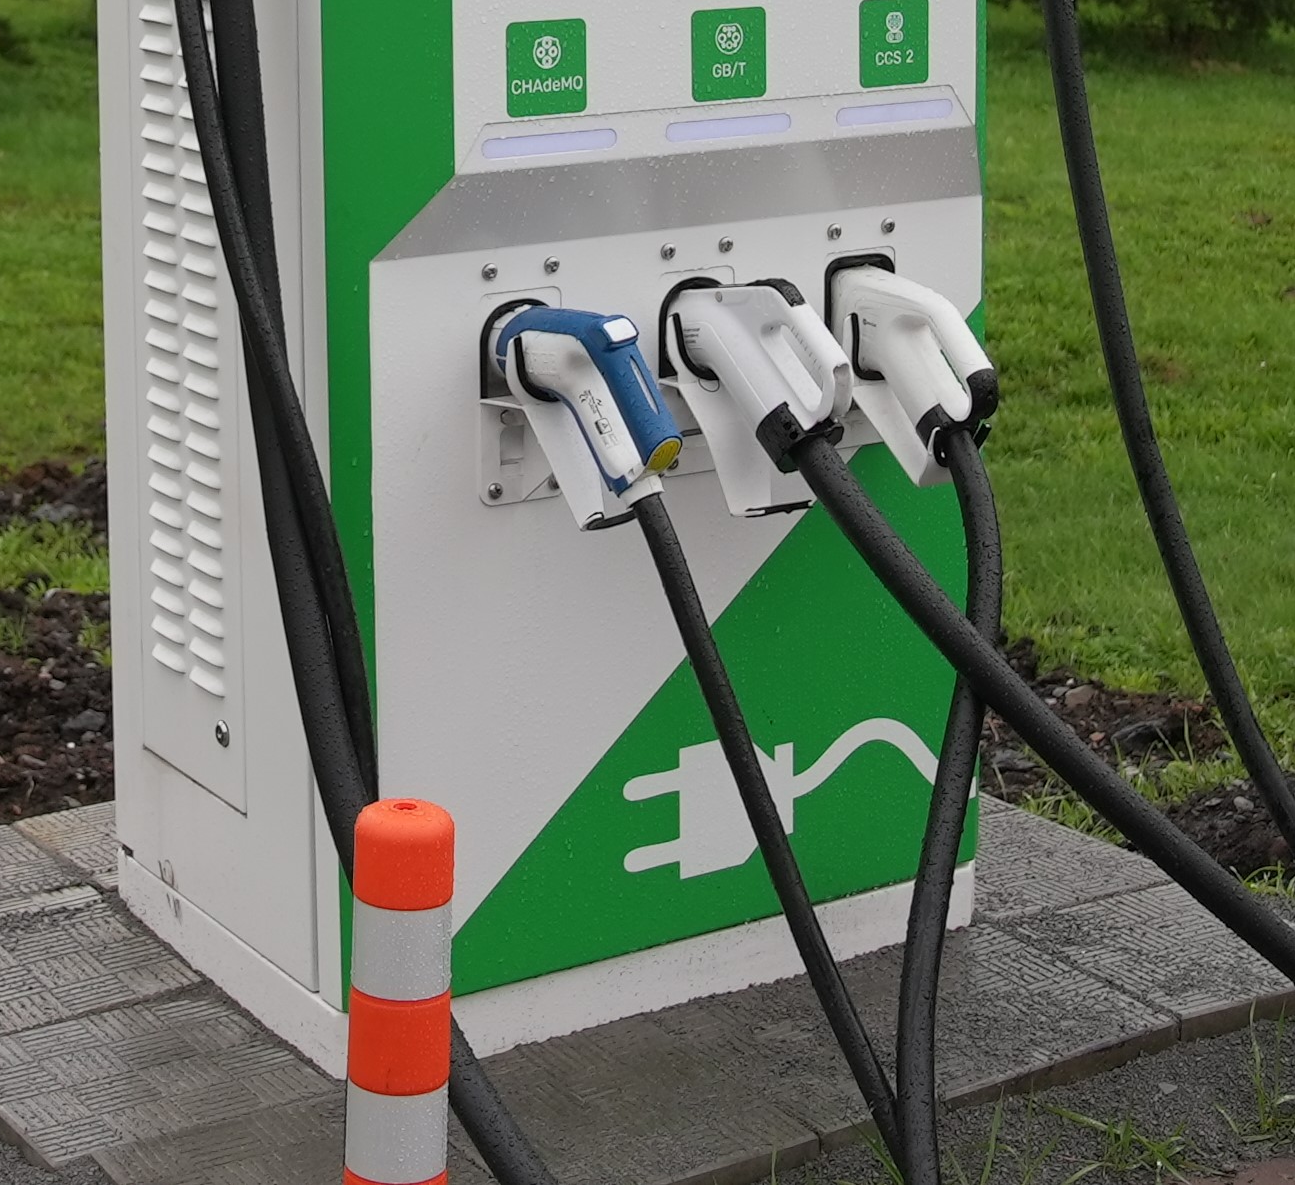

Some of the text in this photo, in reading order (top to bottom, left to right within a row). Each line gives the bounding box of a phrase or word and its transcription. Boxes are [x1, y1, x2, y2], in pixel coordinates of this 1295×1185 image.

[875, 49, 914, 66] CCS 2
[712, 61, 747, 79] GB/T
[511, 75, 584, 95] CHAdeMO
